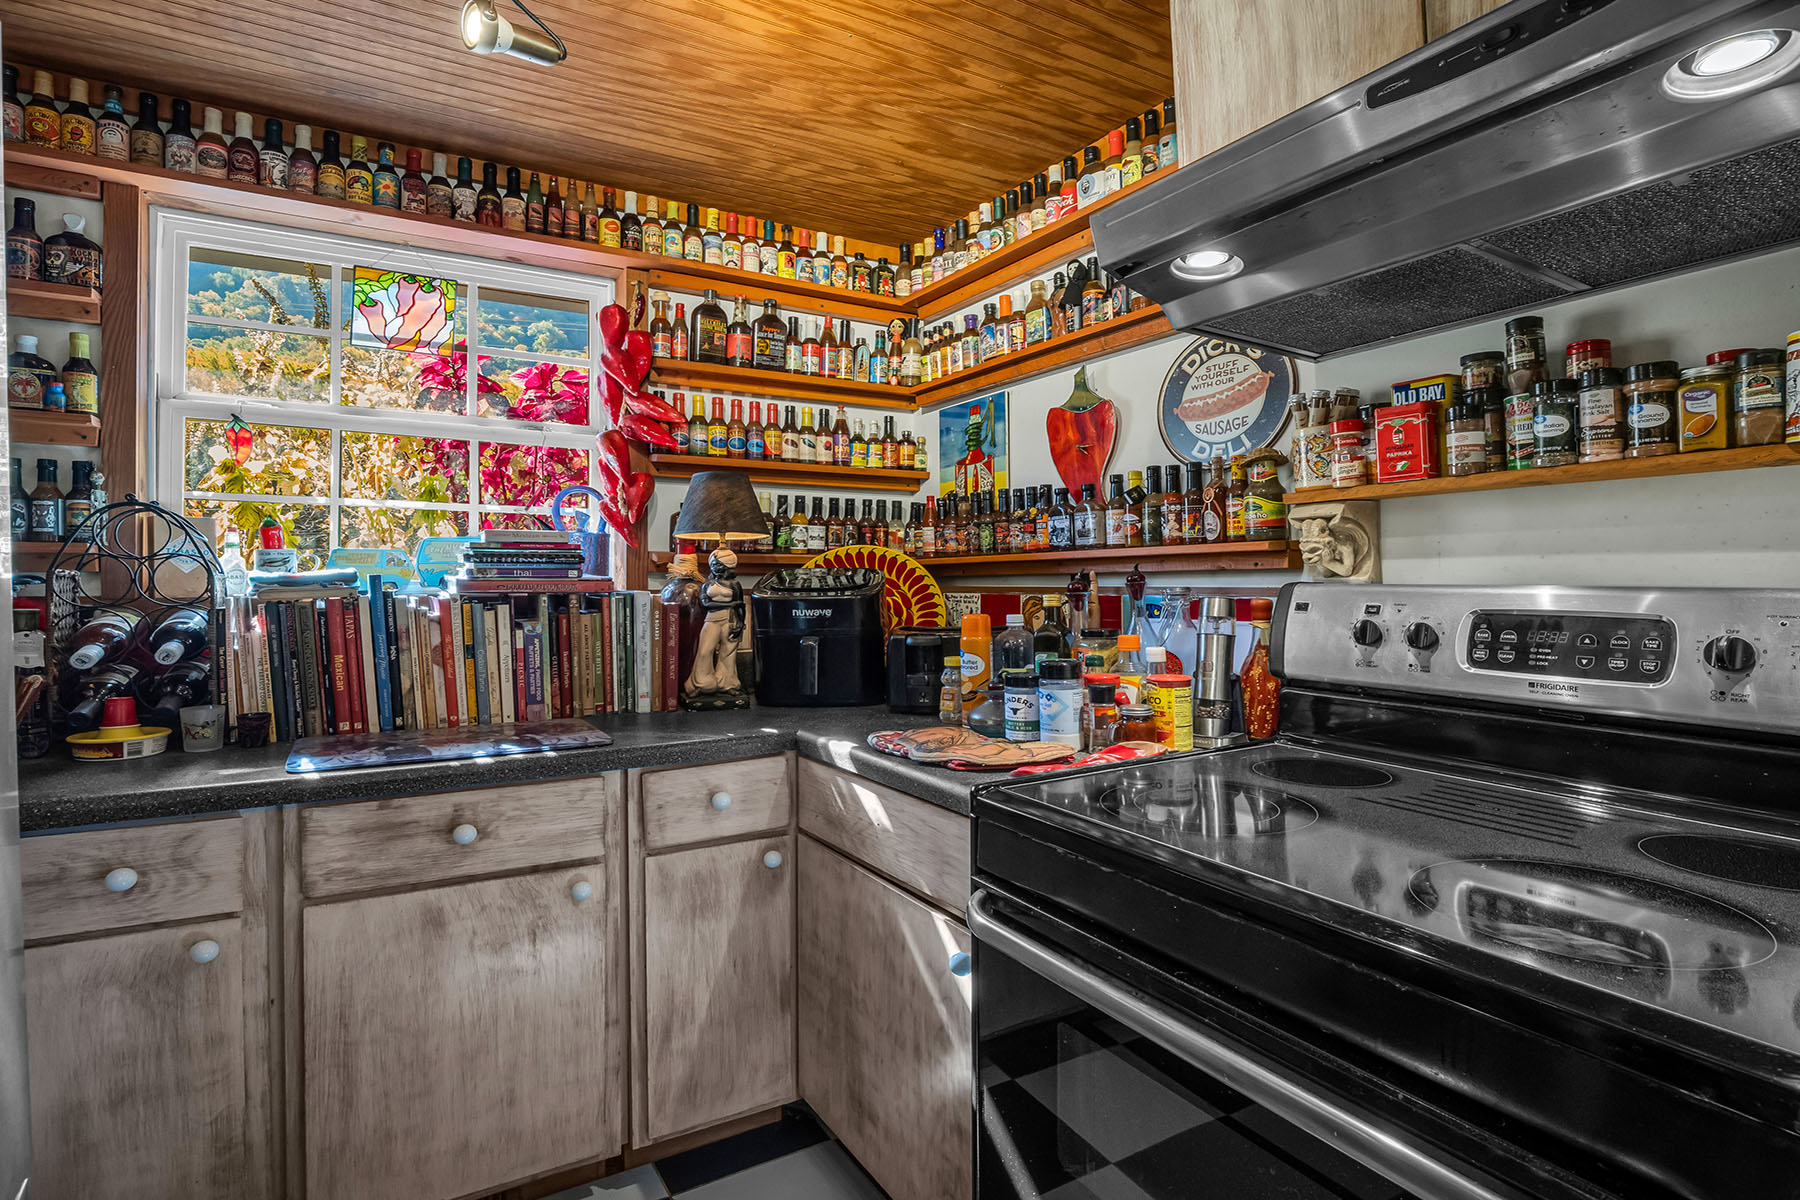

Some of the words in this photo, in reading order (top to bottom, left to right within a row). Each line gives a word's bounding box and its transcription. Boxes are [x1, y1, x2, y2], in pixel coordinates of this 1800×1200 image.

[1206, 359, 1239, 372] STUFF
[1194, 364, 1250, 382] YOURSELF
[1191, 382, 1213, 391] WITH
[1214, 376, 1234, 386] OUR
[1394, 389, 1416, 406] OLD
[1582, 403, 1613, 411] Himalayan
[1638, 412, 1664, 420] Ground
[1194, 416, 1249, 436] SAUSAGE
[1580, 426, 1615, 437] Supreme
[1192, 434, 1252, 458] DELI
[1386, 450, 1412, 458] PAPRIKA
[166, 548, 210, 556] TABASO
[792, 608, 832, 617] nuwave
[346, 615, 354, 638] TAPAS
[334, 655, 344, 691] Mexican
[1536, 682, 1579, 692] FRIGIDAIRE
